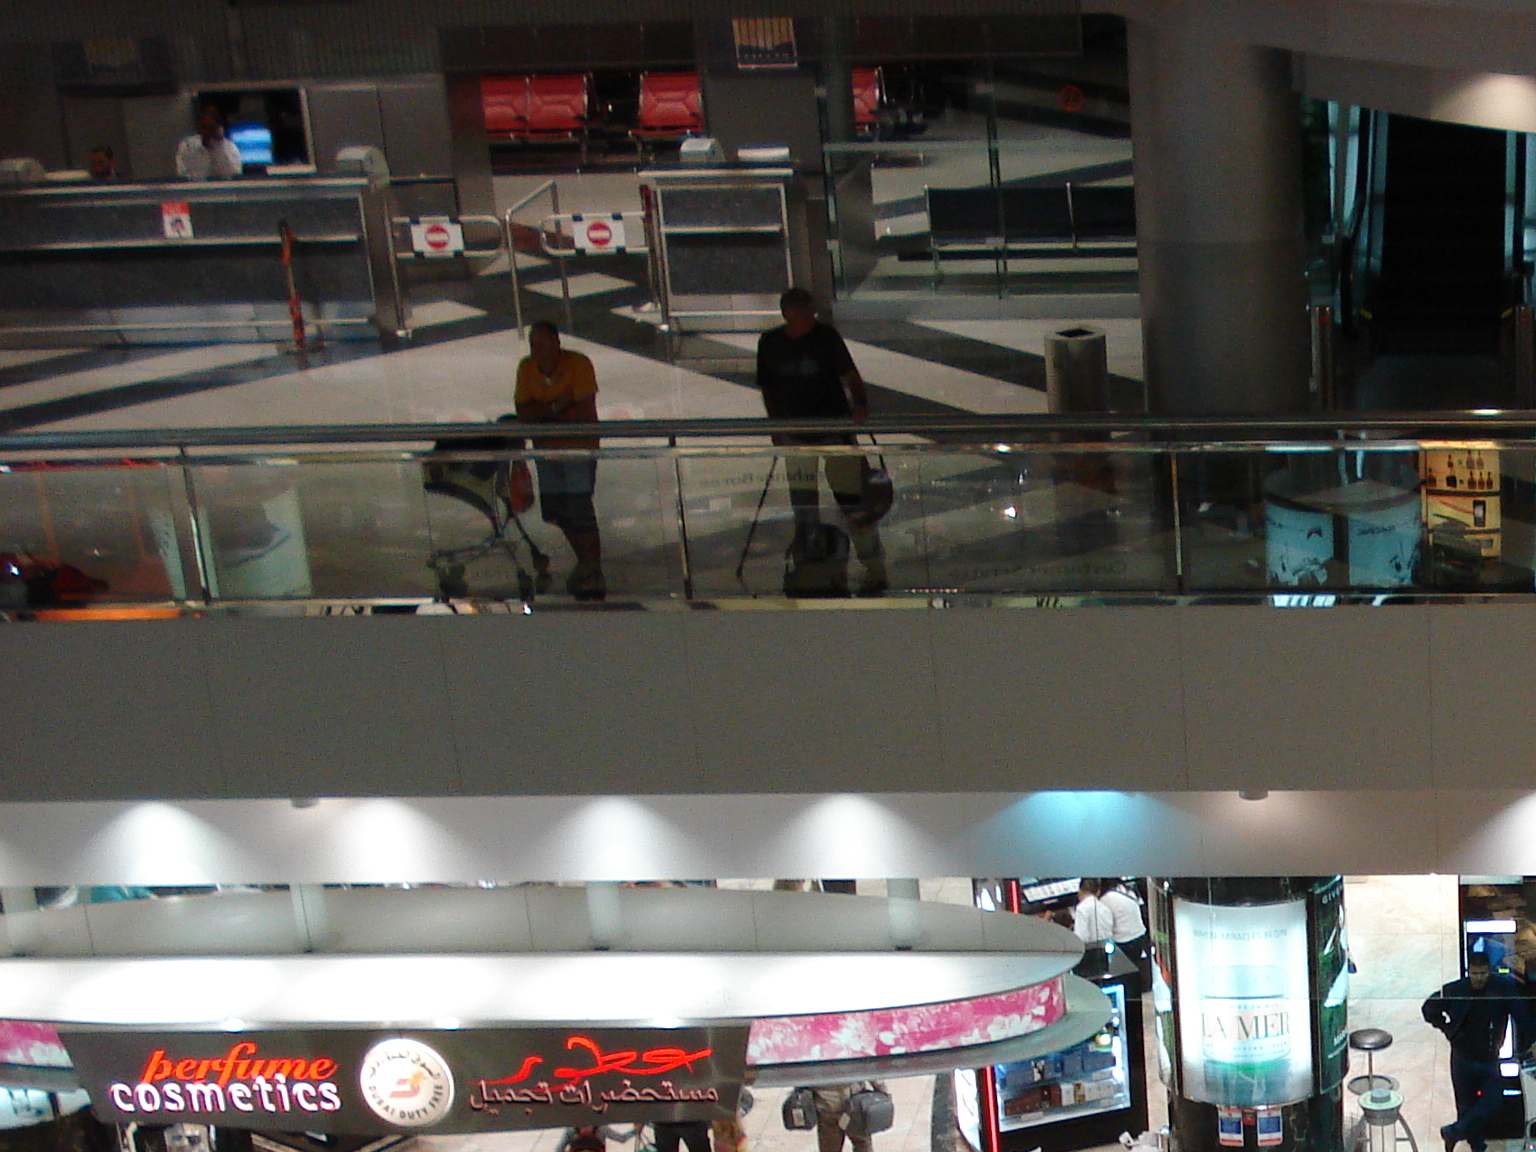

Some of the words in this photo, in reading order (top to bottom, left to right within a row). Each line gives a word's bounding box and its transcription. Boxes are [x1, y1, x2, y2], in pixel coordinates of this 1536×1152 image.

[1201, 1013, 1227, 1039] LA
[1236, 1011, 1291, 1040] MER
[141, 1042, 339, 1087] perfume
[110, 1073, 341, 1113] cosmetics
